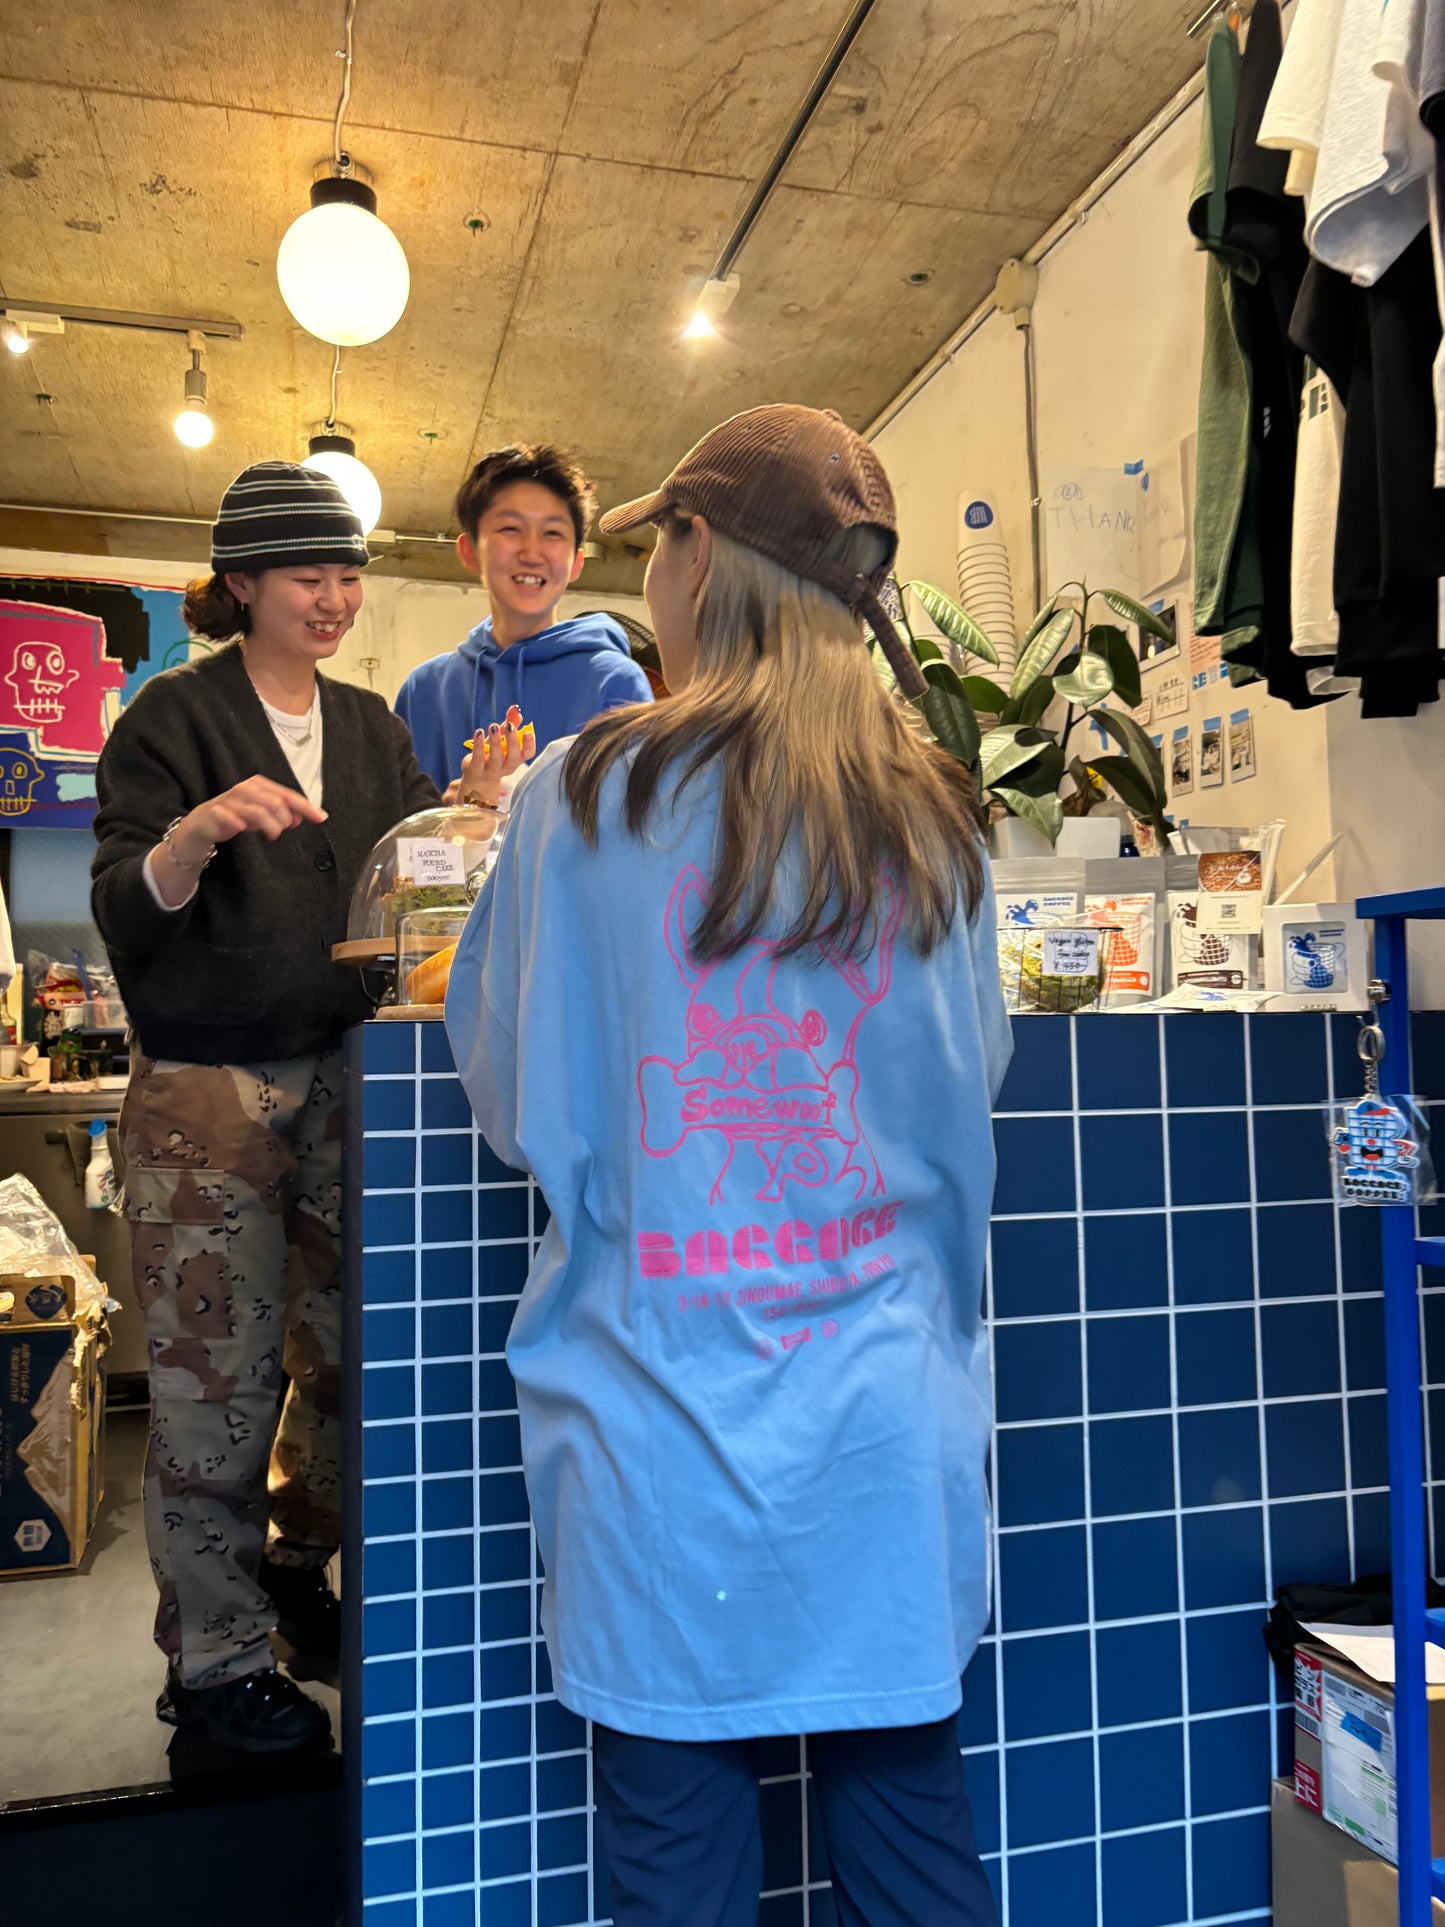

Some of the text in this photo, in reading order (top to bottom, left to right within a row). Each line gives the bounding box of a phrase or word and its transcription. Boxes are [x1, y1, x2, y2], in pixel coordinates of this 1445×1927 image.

[417, 850, 446, 858] MATCHA
[422, 859, 447, 867] POUND
[435, 864, 454, 872] CAKE
[680, 1085, 838, 1125] Somewoof
[637, 1200, 904, 1279] BAGGAGE
